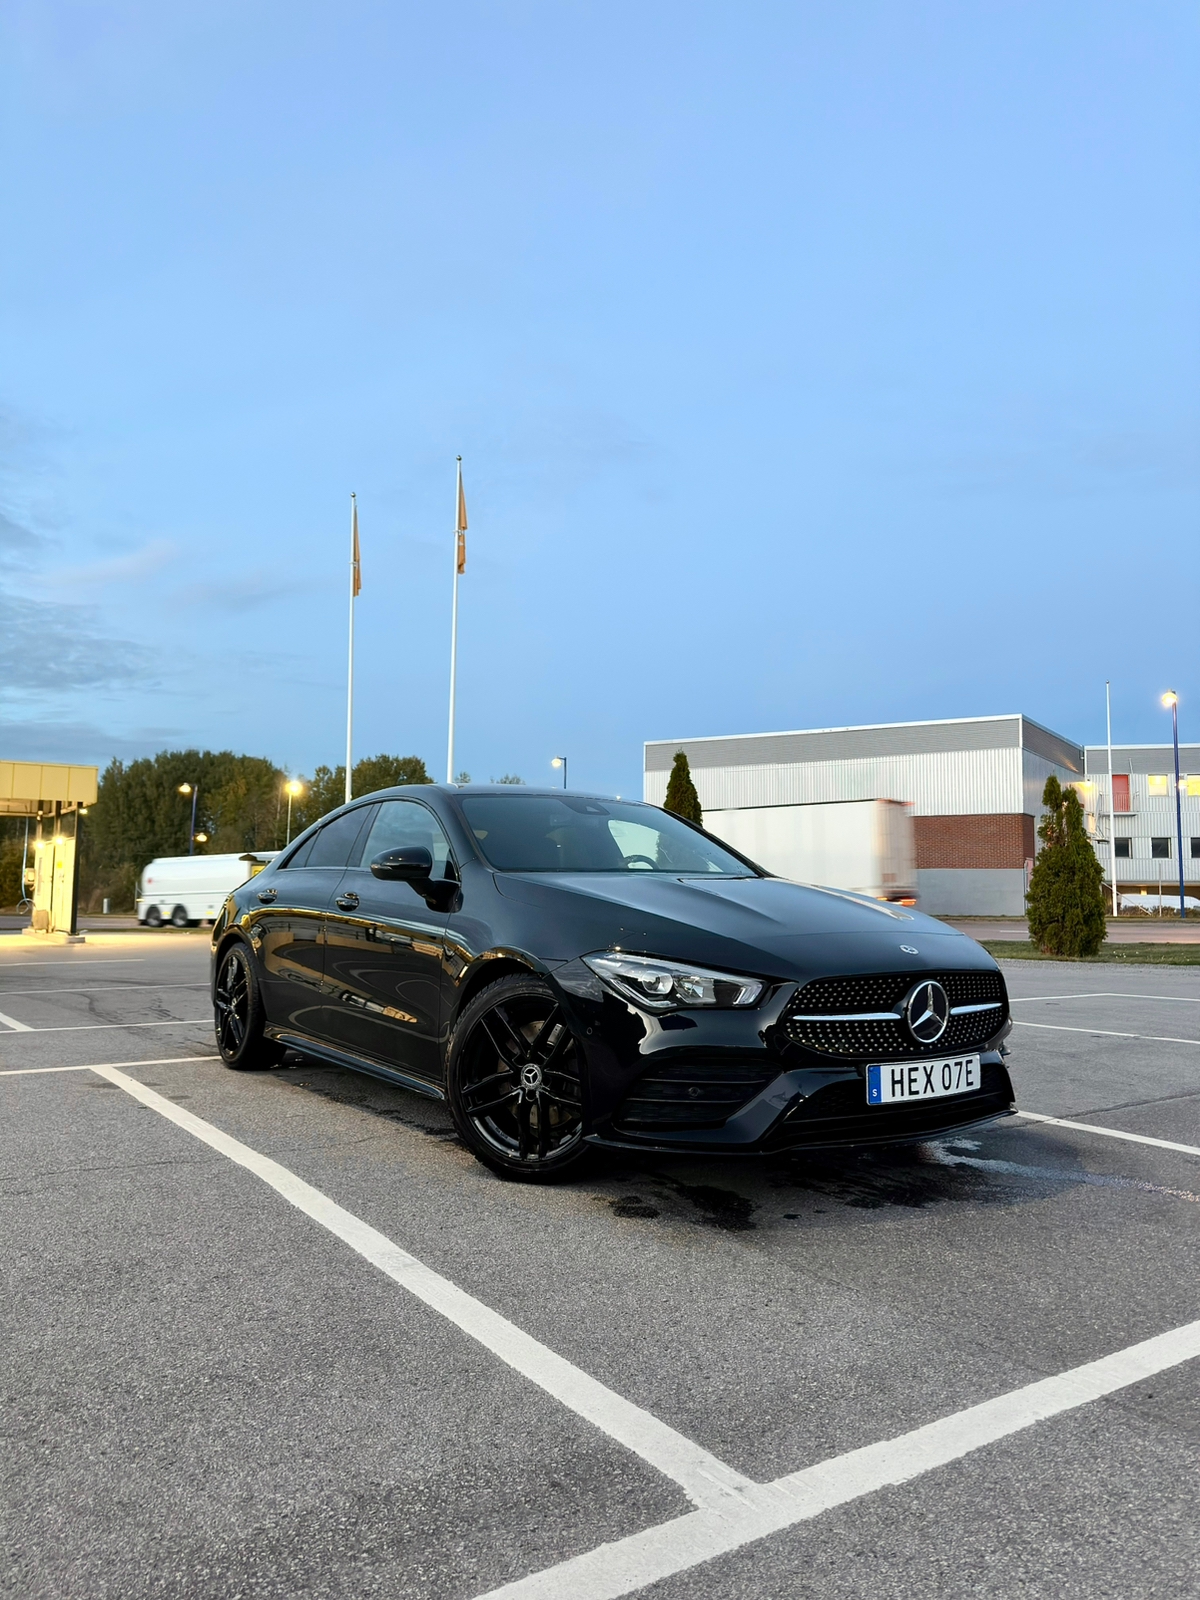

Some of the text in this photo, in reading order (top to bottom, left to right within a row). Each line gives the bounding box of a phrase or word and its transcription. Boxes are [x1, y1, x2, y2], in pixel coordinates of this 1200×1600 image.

[891, 1059, 974, 1097] HEX 07E
[872, 1088, 878, 1097] S
